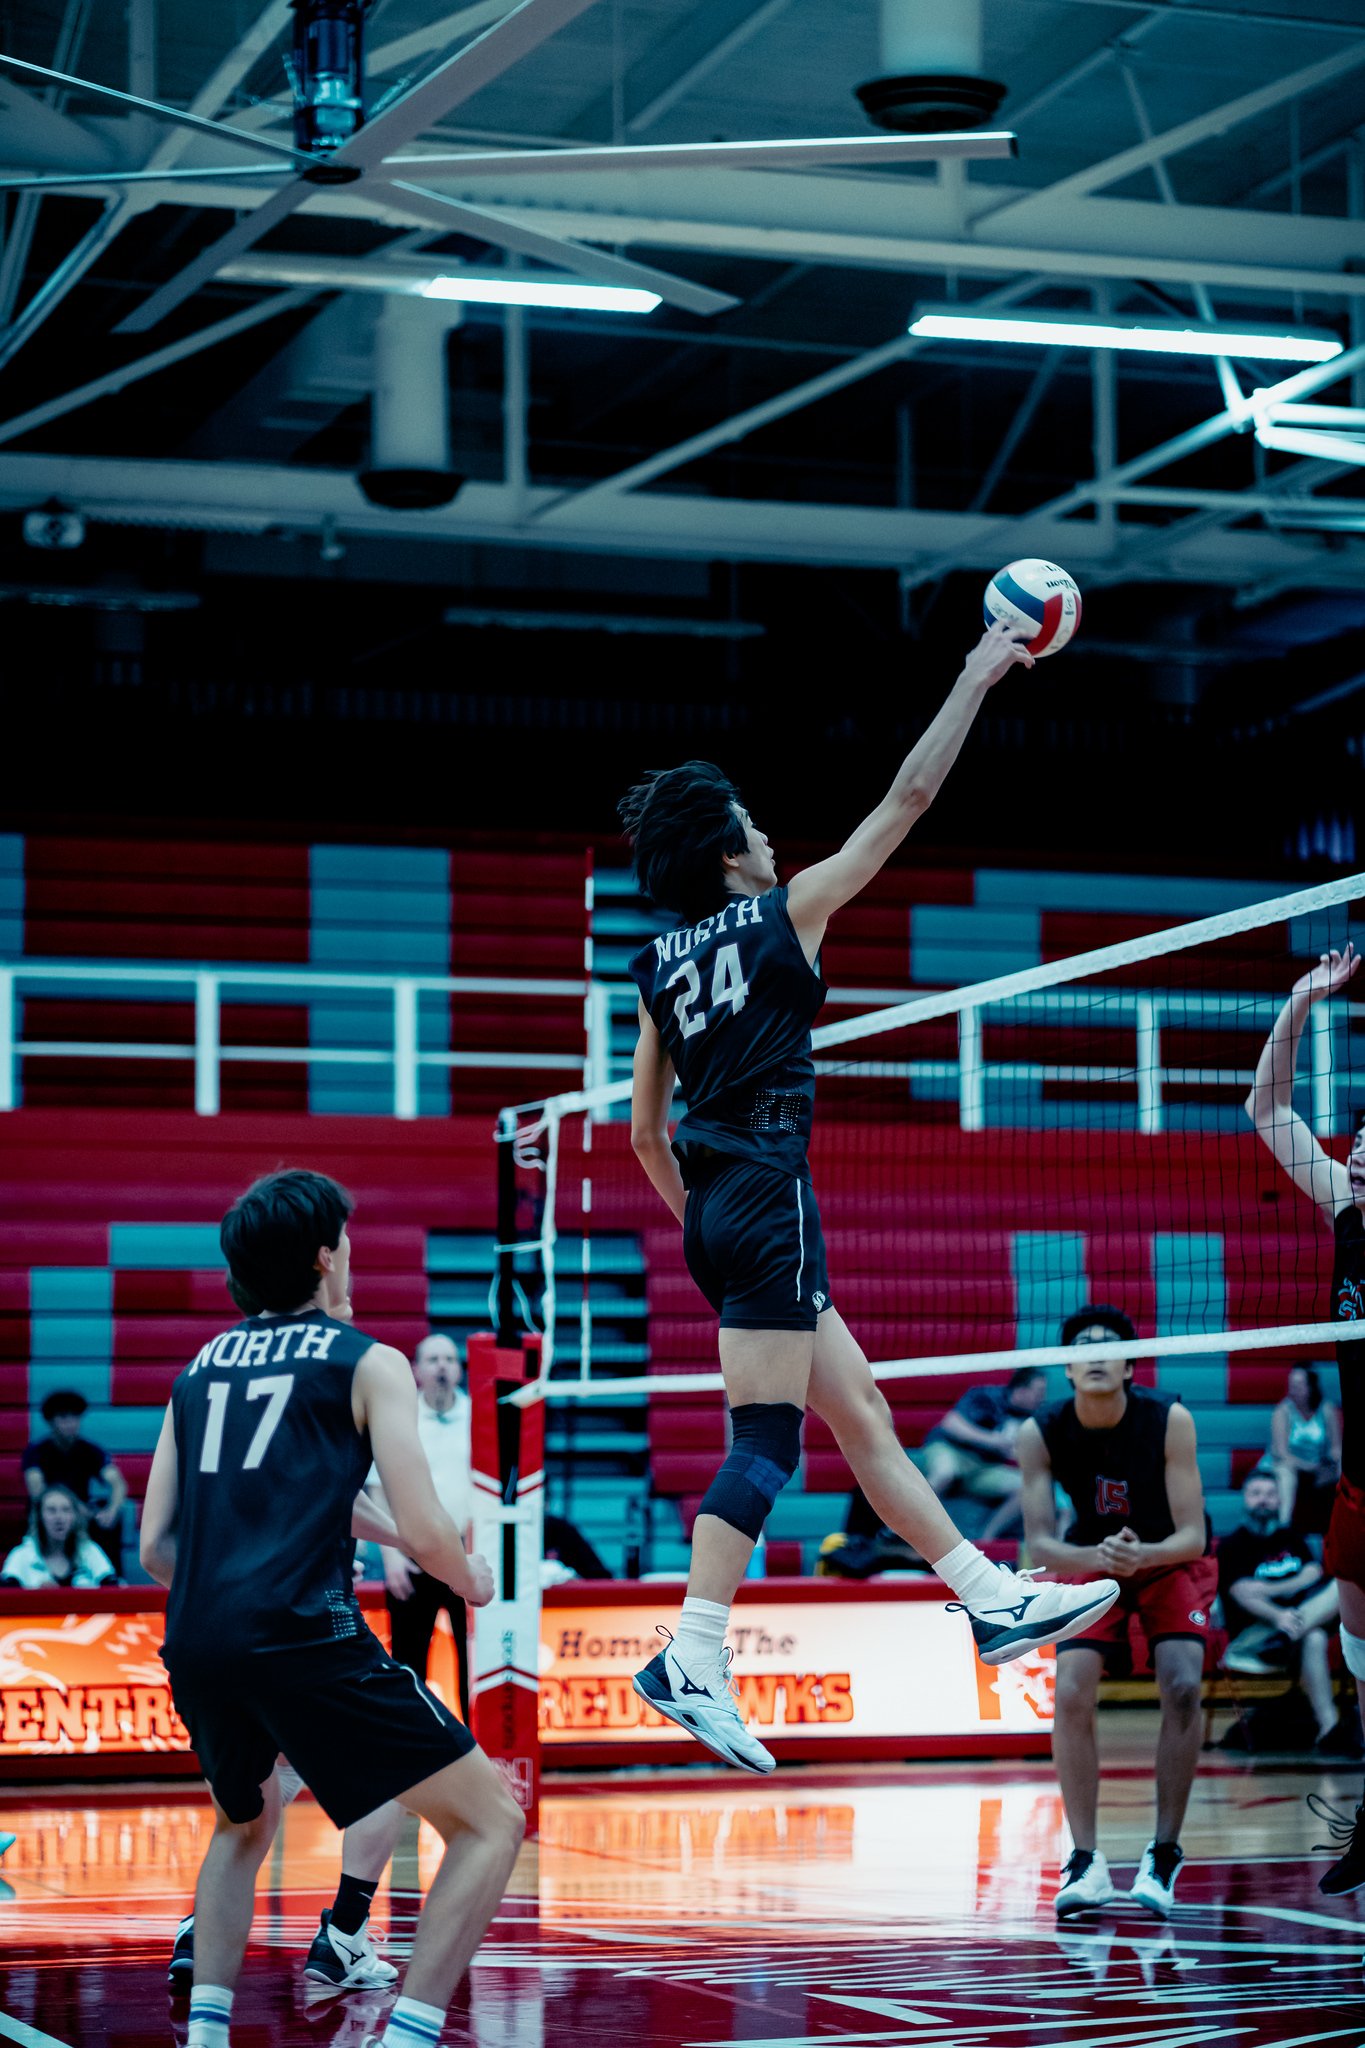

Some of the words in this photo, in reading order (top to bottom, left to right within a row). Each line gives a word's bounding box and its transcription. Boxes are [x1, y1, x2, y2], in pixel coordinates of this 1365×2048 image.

[654, 896, 763, 972] NORTH
[665, 943, 749, 1040] 24
[189, 1323, 341, 1376] NORTH
[200, 1373, 295, 1473] 17
[1095, 1475, 1129, 1515] 15
[559, 1629, 664, 1658] Home
[732, 1626, 797, 1655] The
[538, 1672, 855, 1728] REDWKS
